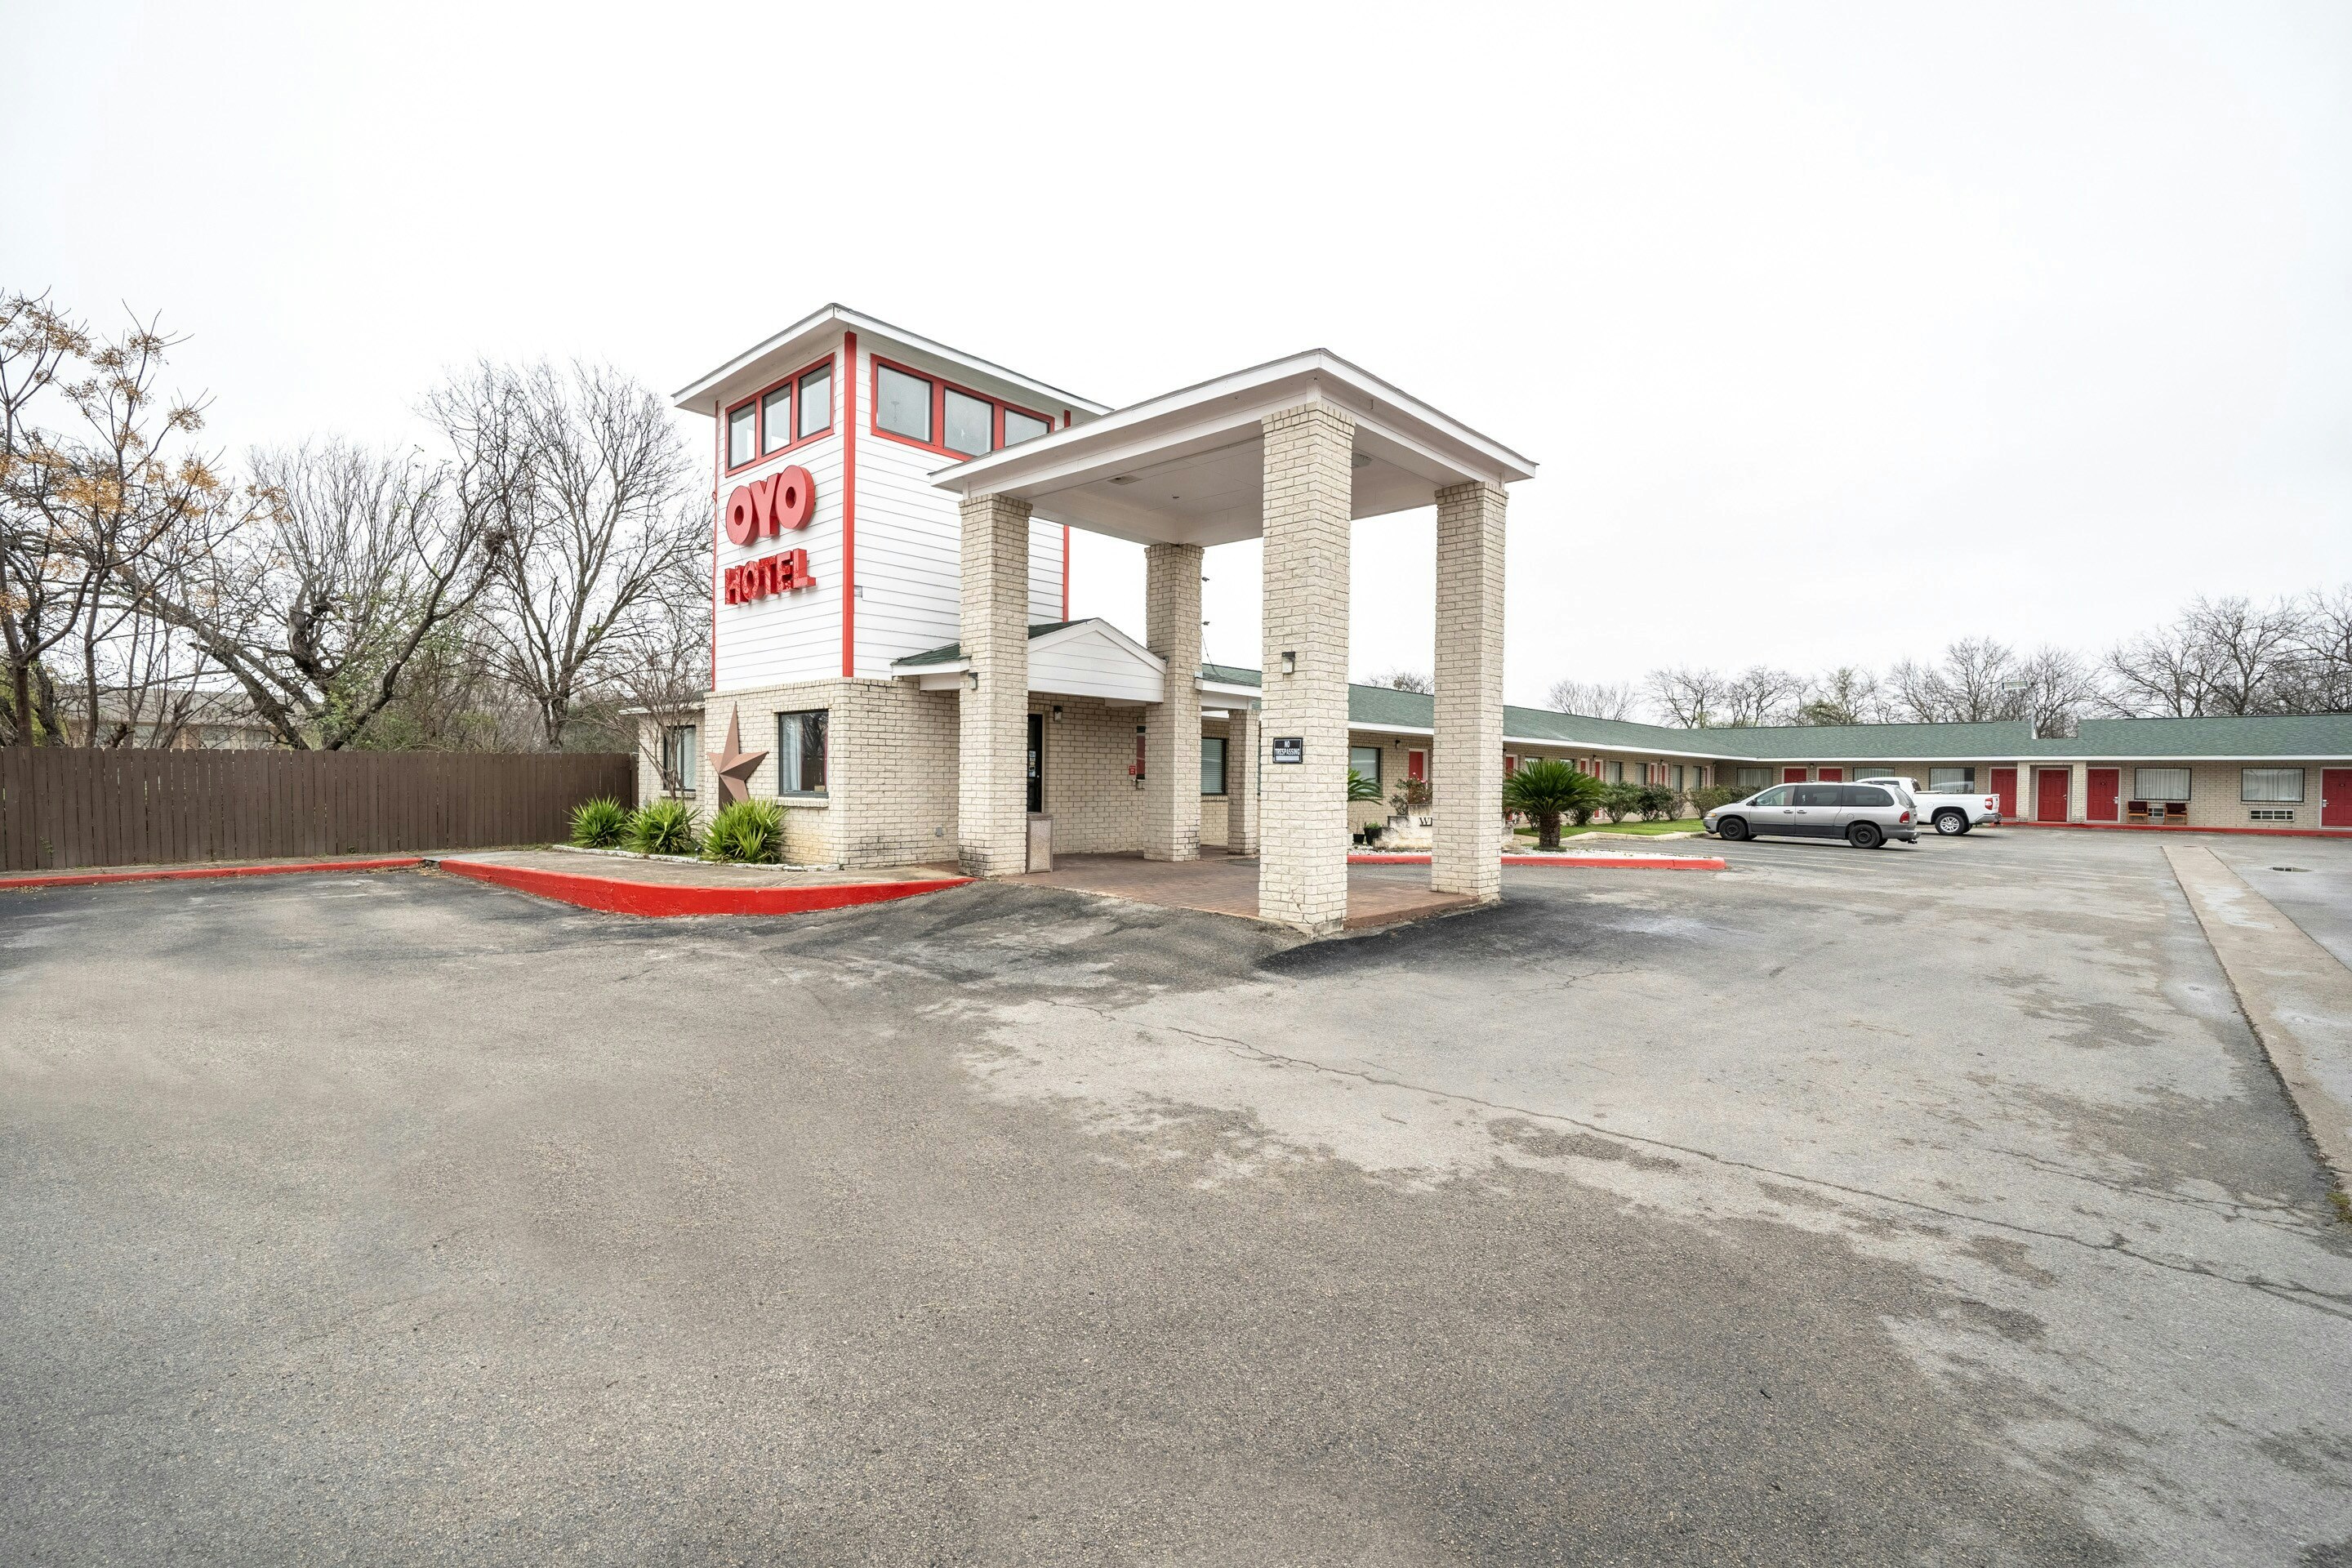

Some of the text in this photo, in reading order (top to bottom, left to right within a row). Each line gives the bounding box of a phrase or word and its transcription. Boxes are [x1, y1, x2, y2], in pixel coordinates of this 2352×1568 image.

[725, 465, 815, 546] OYO
[724, 548, 816, 605] HOTEL
[1275, 747, 1300, 755] TRESPASSING
[1284, 740, 1290, 748] NO
